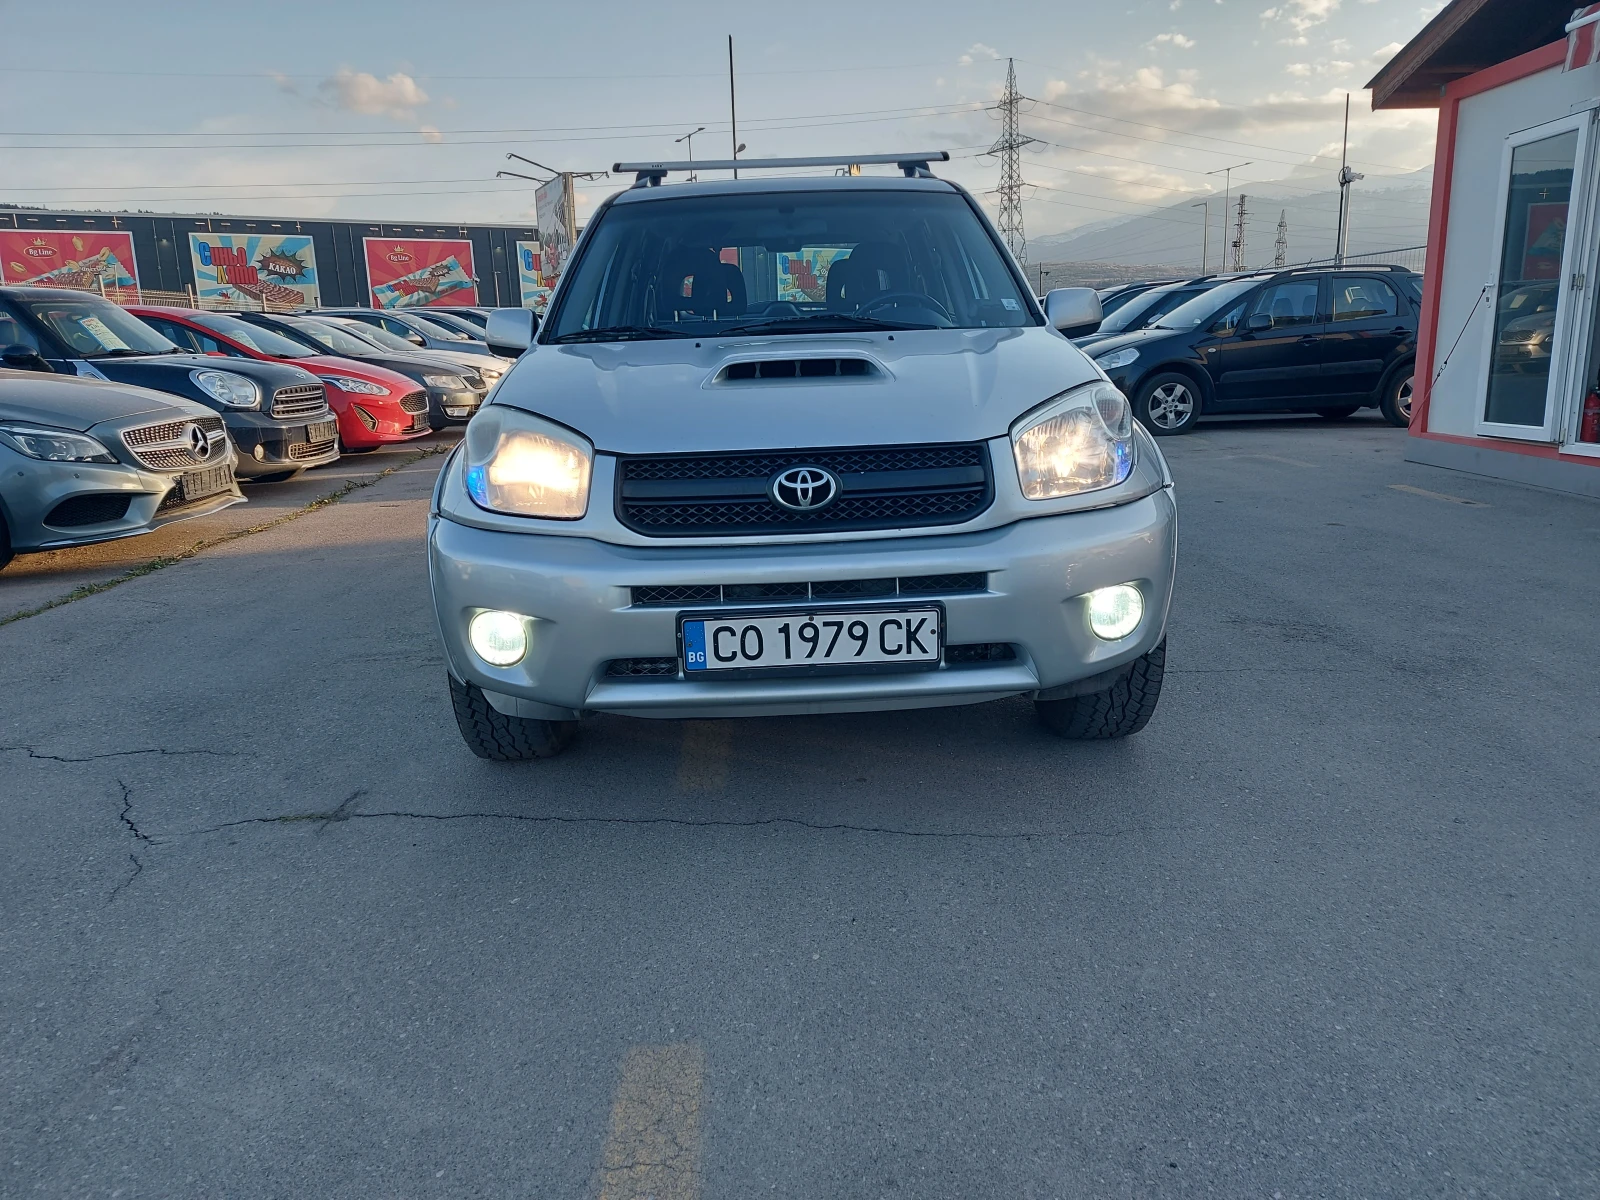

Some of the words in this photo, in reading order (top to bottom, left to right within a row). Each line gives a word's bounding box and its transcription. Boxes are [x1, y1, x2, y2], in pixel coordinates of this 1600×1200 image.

[28, 248, 39, 257] Bg
[39, 248, 53, 256] Line
[777, 620, 870, 660] 1979
[688, 651, 705, 663] BG
